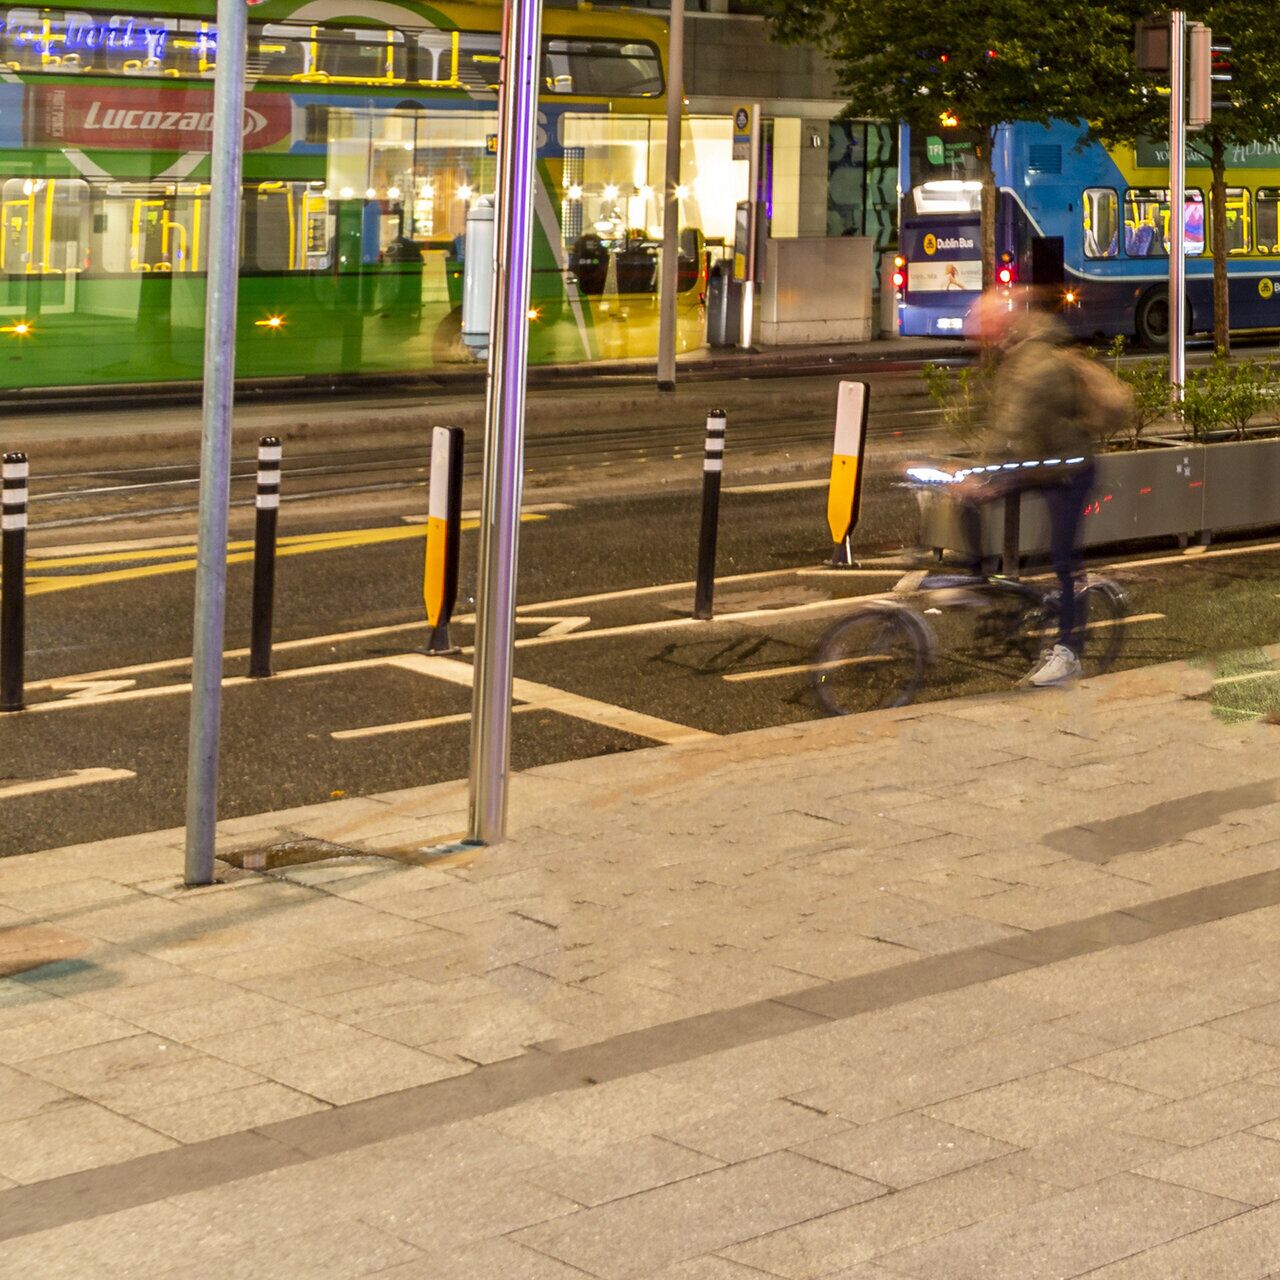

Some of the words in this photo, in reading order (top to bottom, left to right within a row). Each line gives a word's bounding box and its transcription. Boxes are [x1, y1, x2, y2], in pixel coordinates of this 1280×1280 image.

[83, 101, 215, 131] Lucozad
[936, 238, 959, 249] Dublin
[959, 237, 974, 248] Bus
